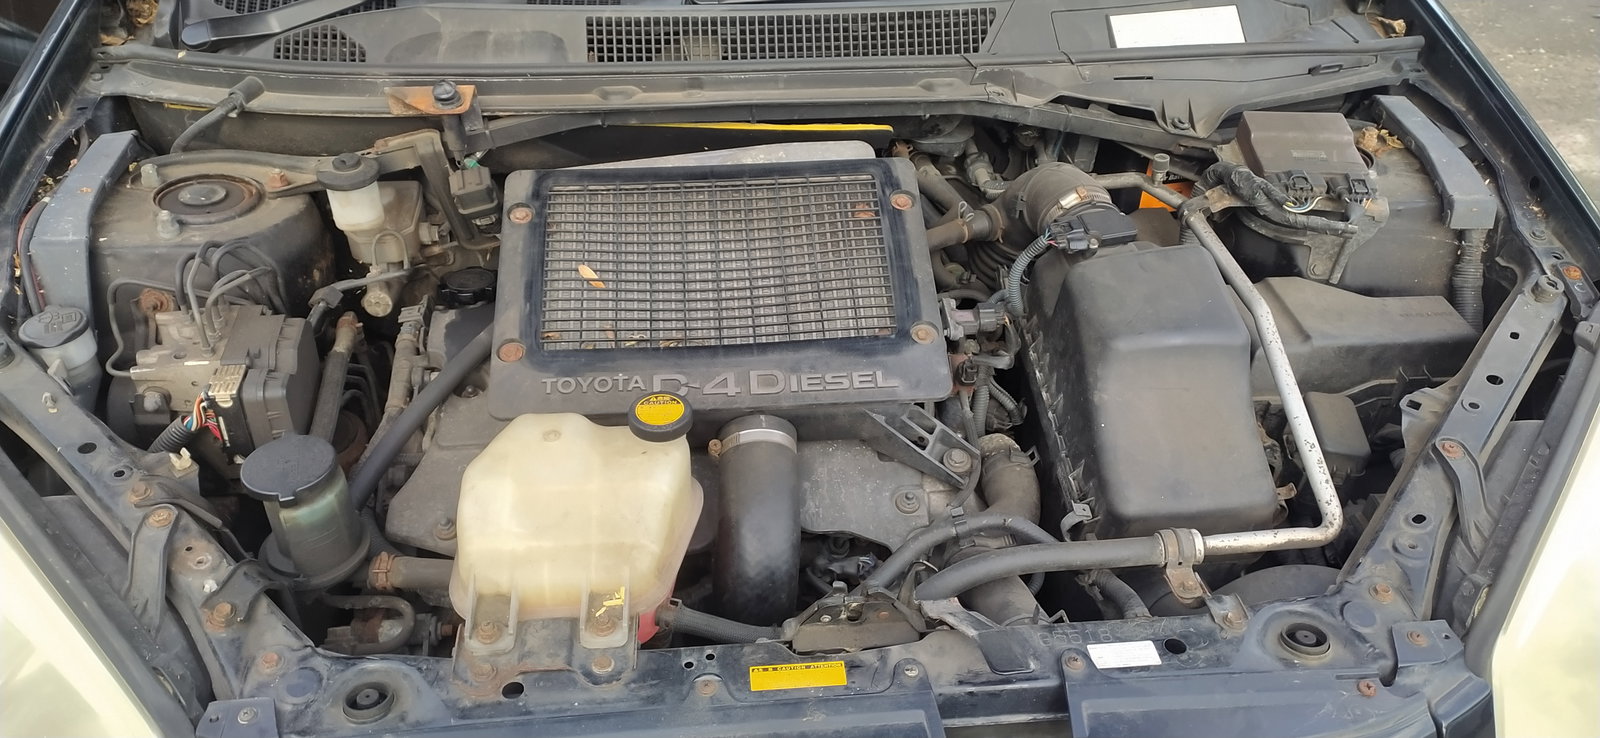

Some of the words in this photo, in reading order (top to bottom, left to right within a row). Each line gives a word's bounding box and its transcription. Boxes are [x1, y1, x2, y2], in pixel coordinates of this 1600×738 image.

[541, 375, 647, 394] TOYOTA
[652, 371, 742, 397] D-4
[750, 369, 900, 395] DIESEL
